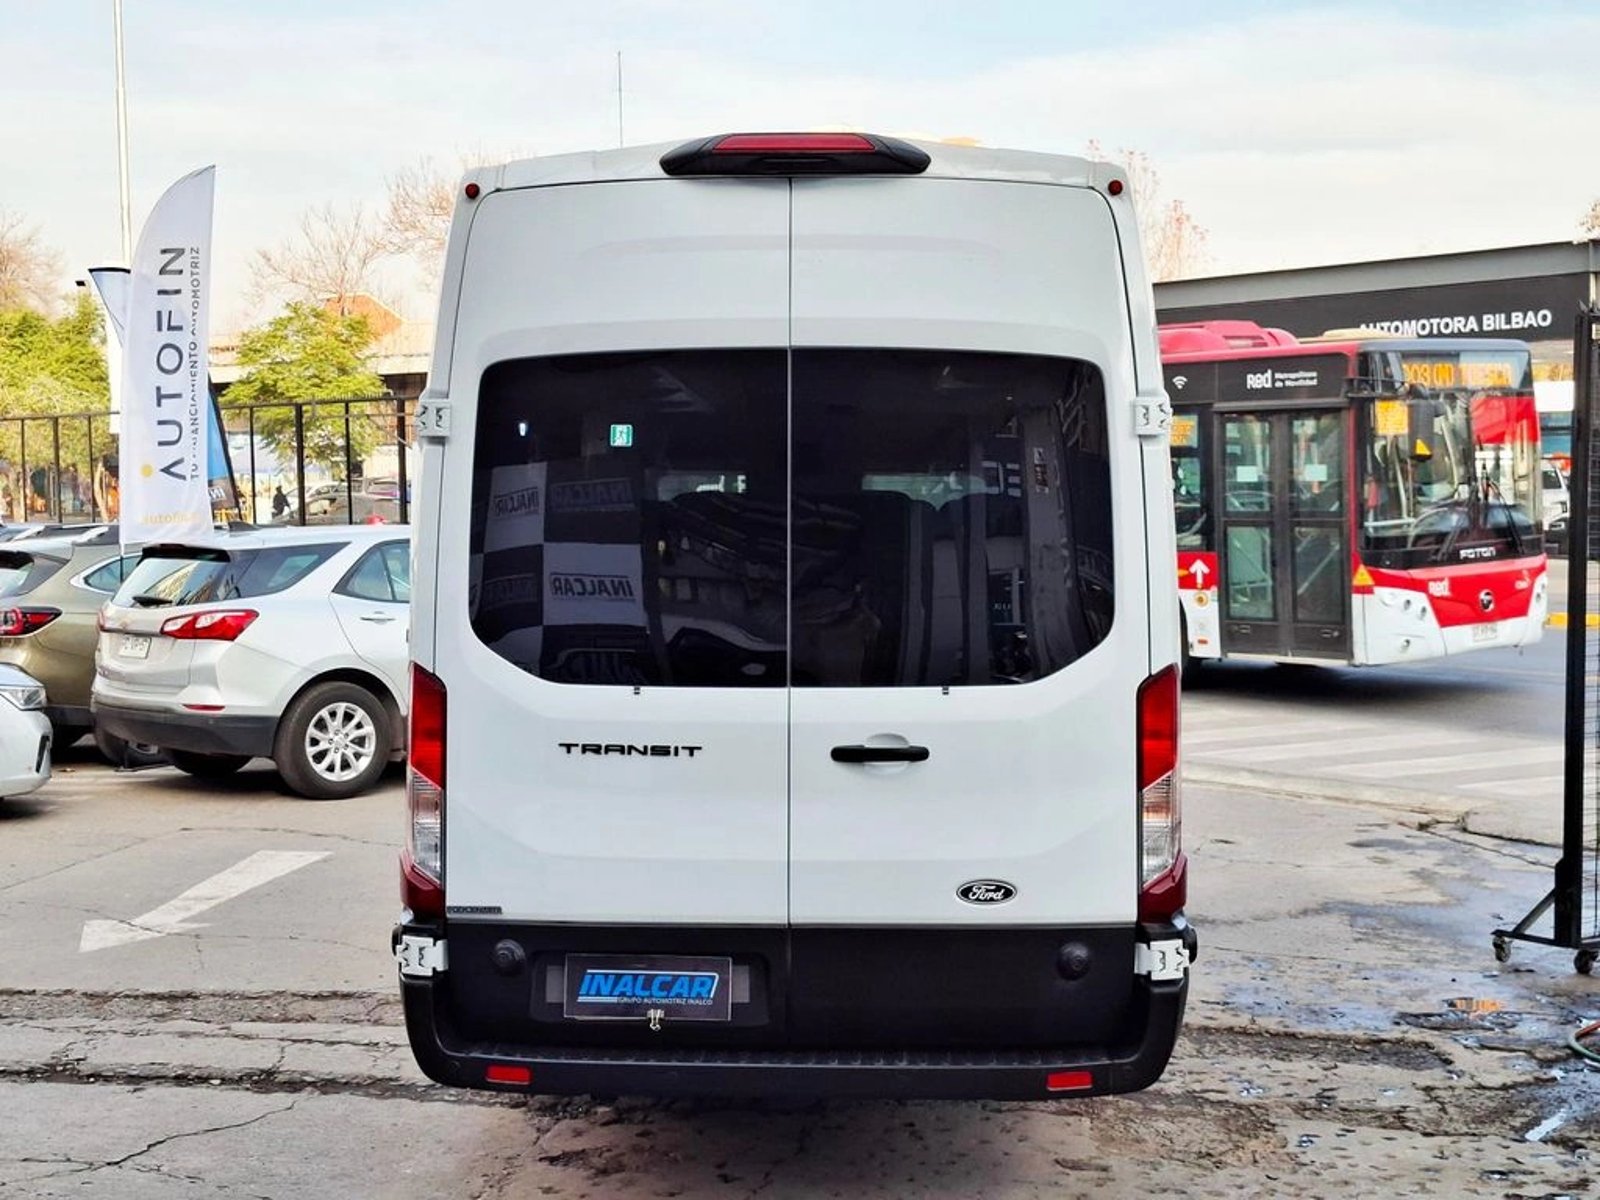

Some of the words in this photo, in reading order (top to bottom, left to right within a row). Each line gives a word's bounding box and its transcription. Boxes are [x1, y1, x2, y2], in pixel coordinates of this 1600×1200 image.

[1483, 309, 1552, 331] BILBAO
[156, 247, 187, 481] AUTOFIN
[558, 743, 702, 757] TRANSIT
[968, 885, 1005, 900] Ford
[579, 974, 715, 998] INALCAR
